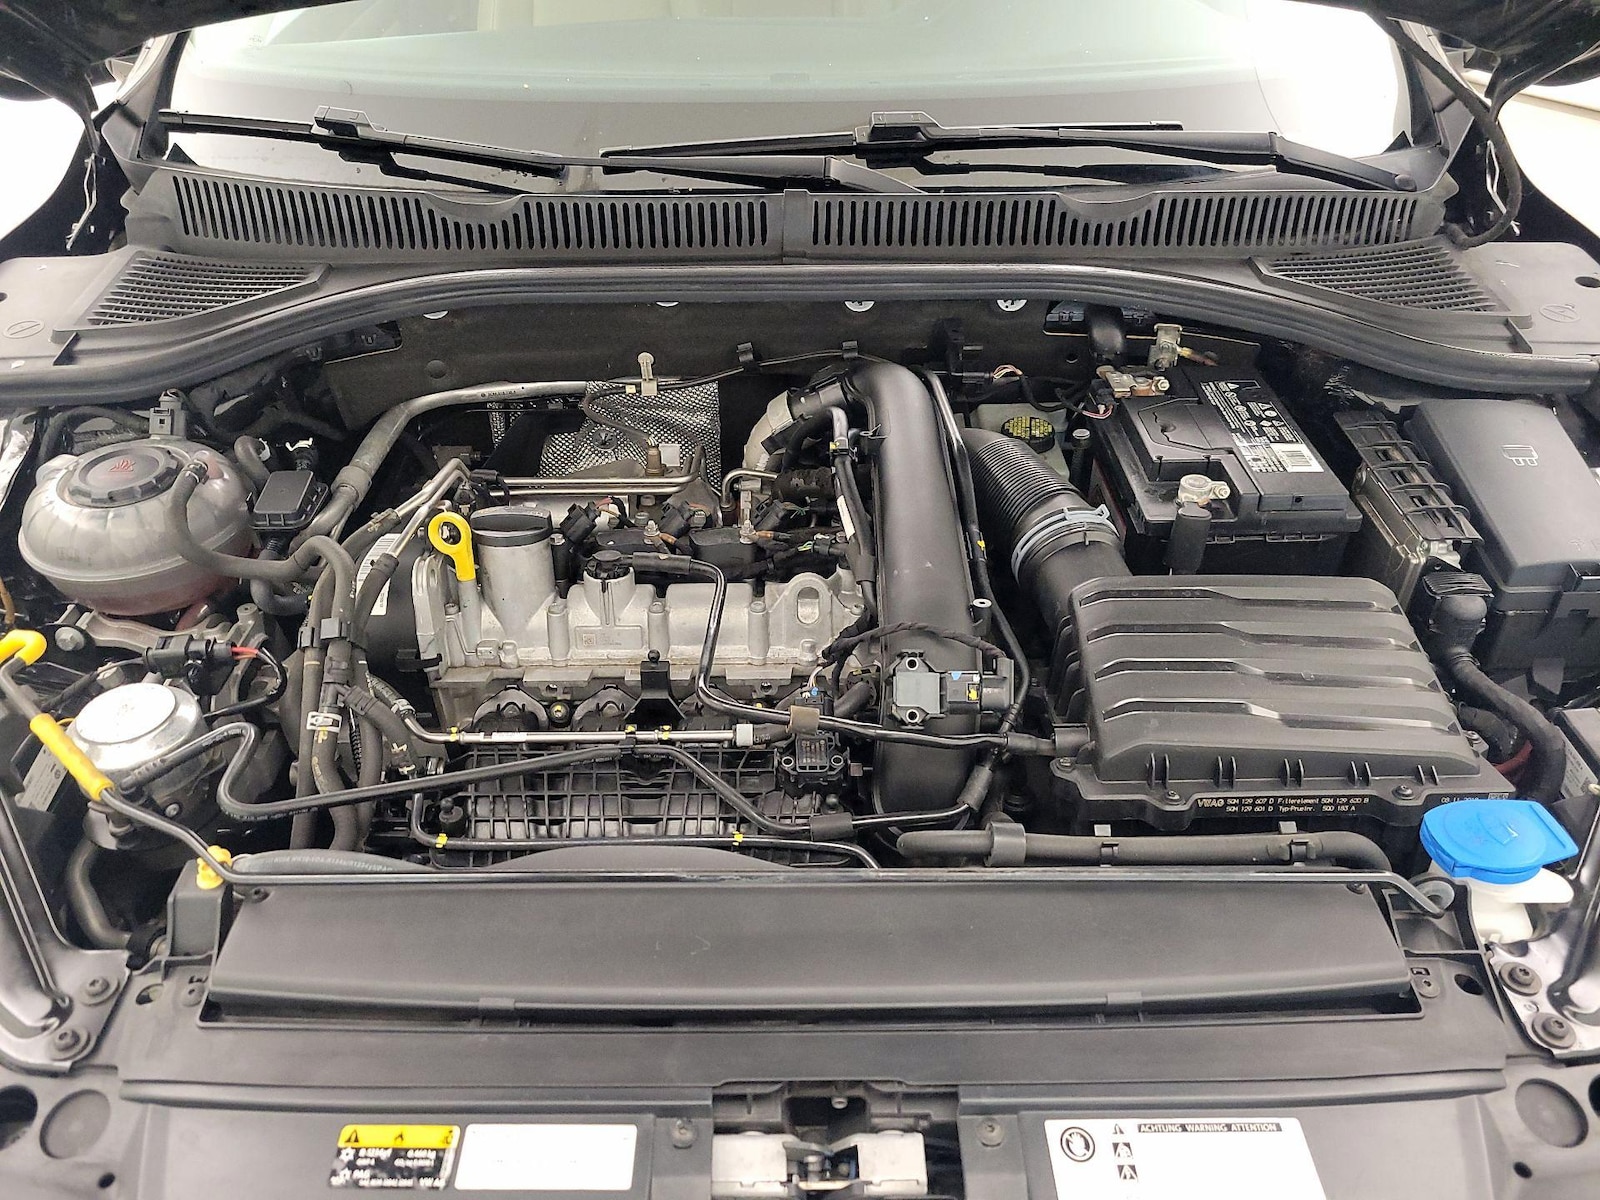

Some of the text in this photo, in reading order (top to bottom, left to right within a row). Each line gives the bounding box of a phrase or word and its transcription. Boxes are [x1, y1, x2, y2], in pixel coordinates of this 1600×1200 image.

[1197, 799, 1225, 808] VWAG
[1139, 1122, 1277, 1133] ACHTUNG WARNING ATTENTION
